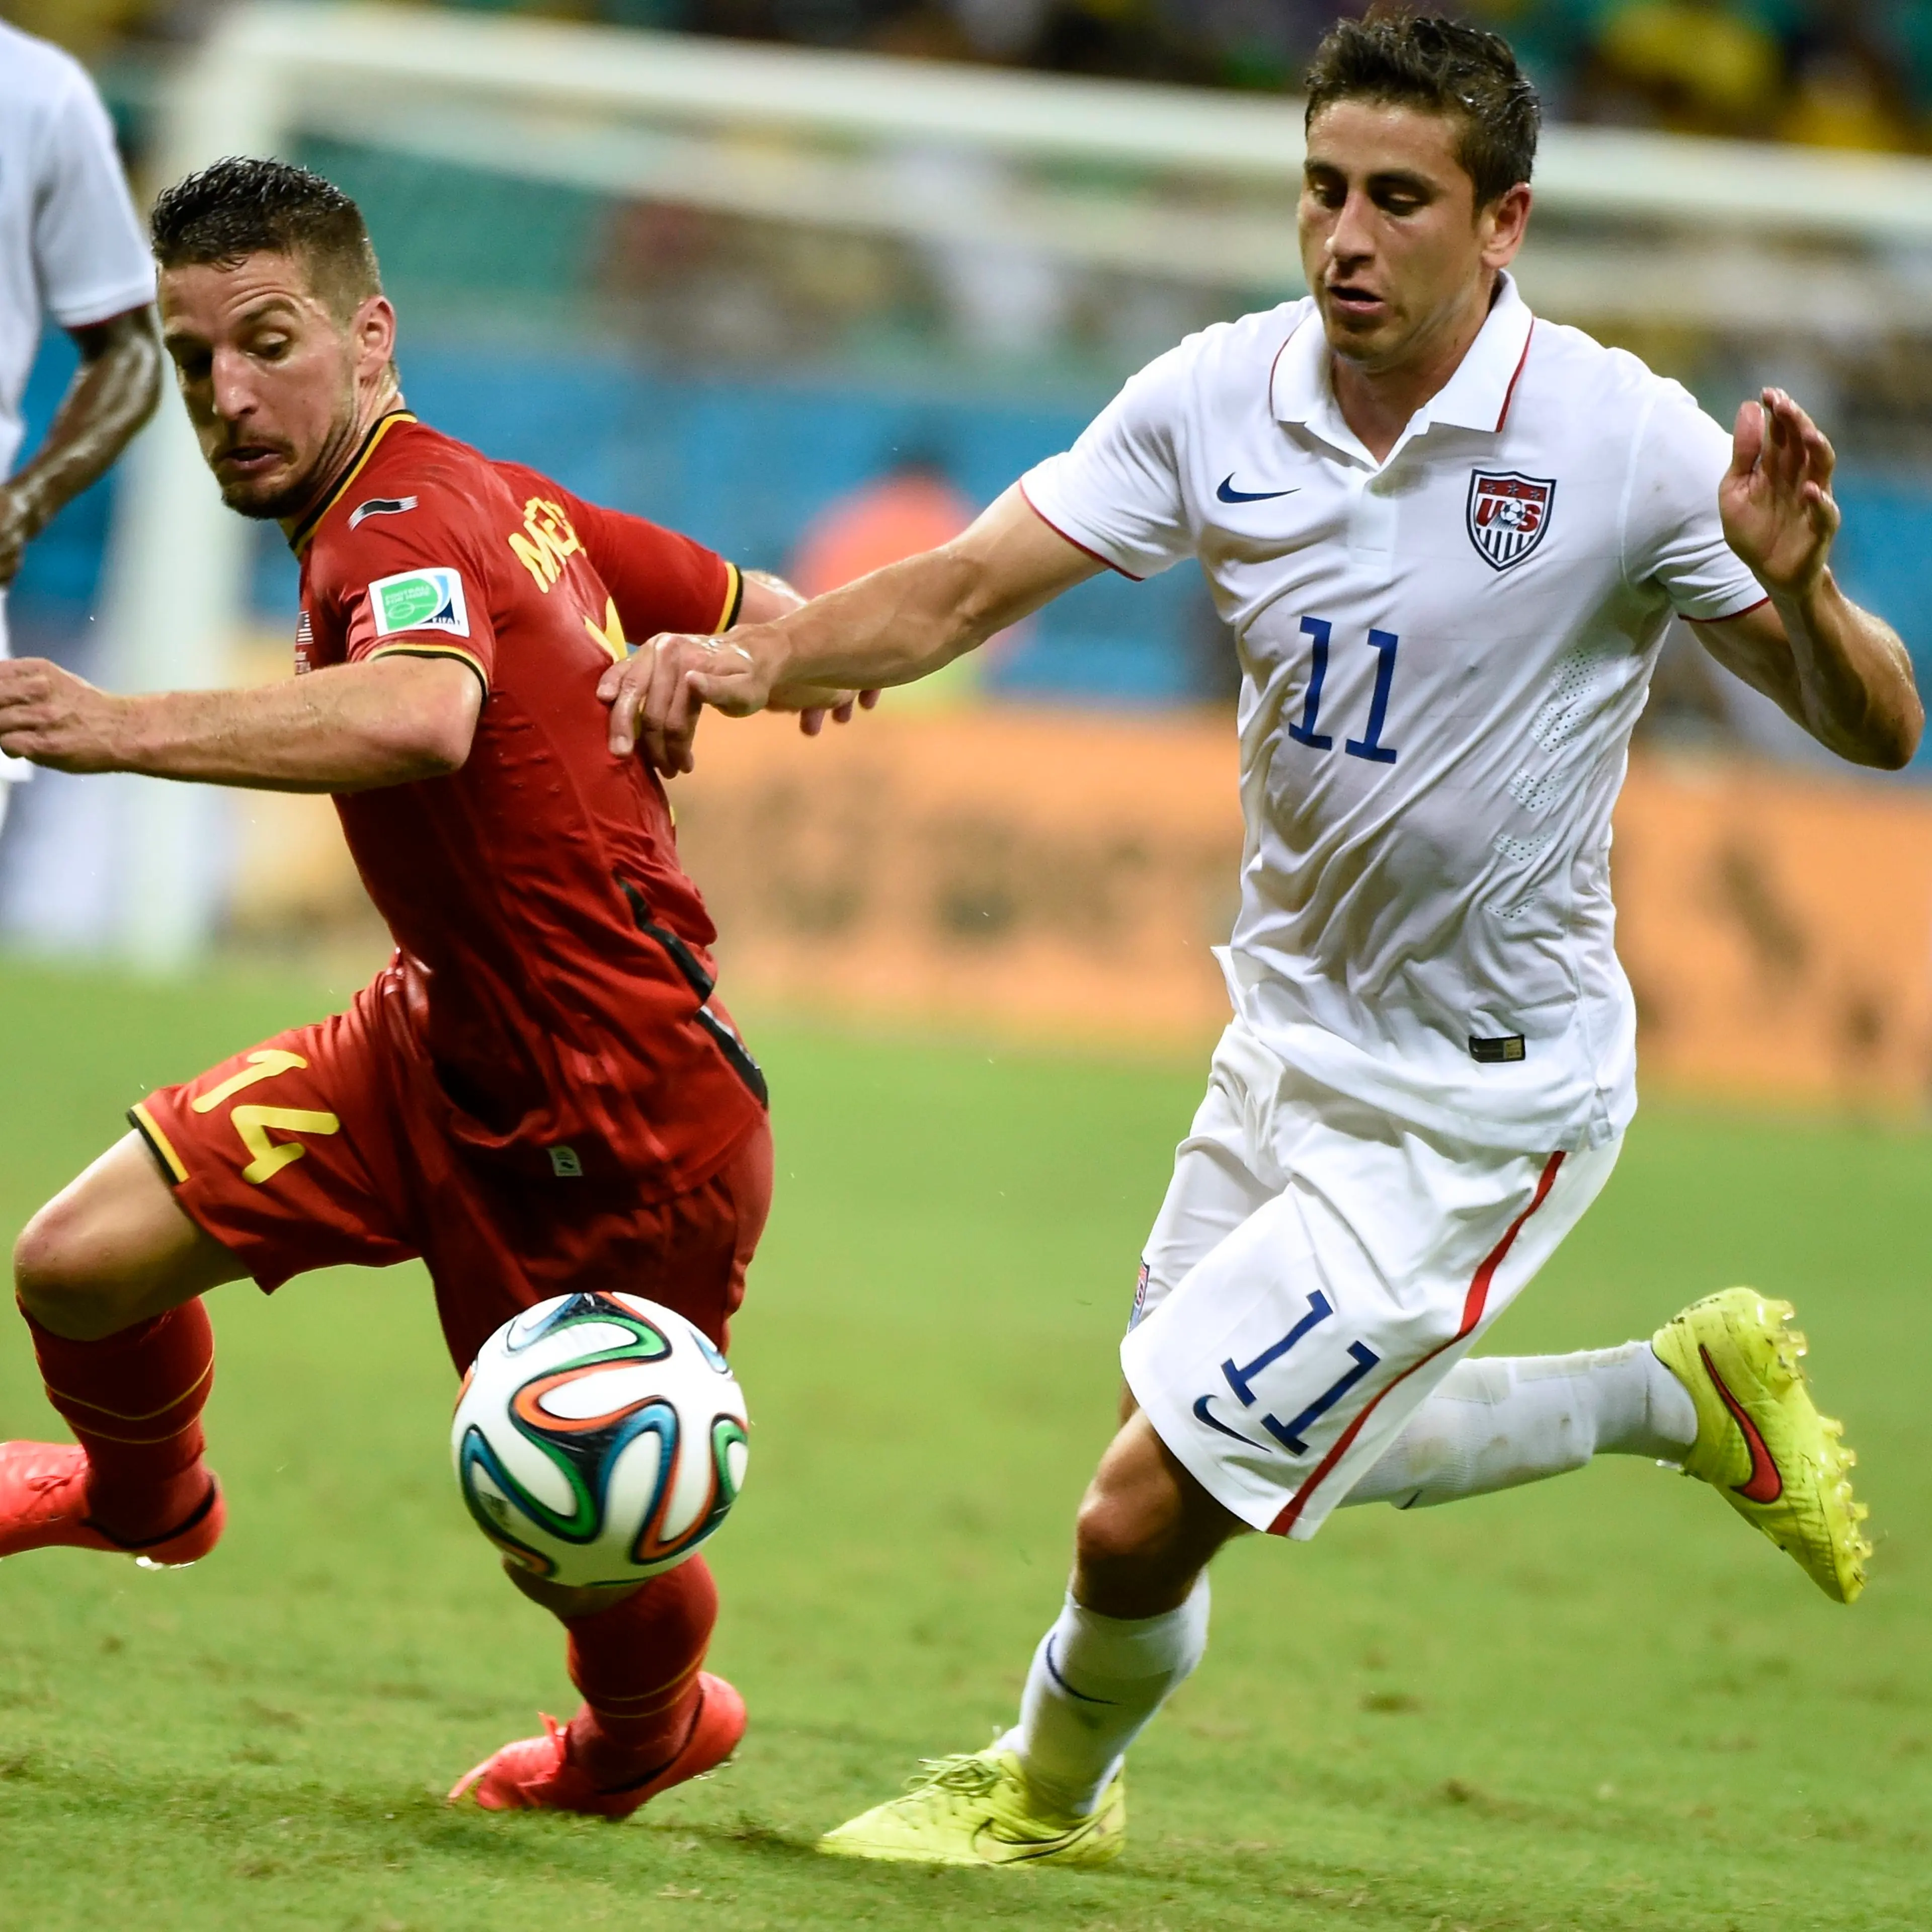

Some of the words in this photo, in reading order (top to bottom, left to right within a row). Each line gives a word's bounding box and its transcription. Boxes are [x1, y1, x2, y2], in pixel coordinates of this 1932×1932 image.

[1476, 497, 1541, 533] US
[1289, 616, 1398, 764] 11
[1221, 1290, 1381, 1456] 11
